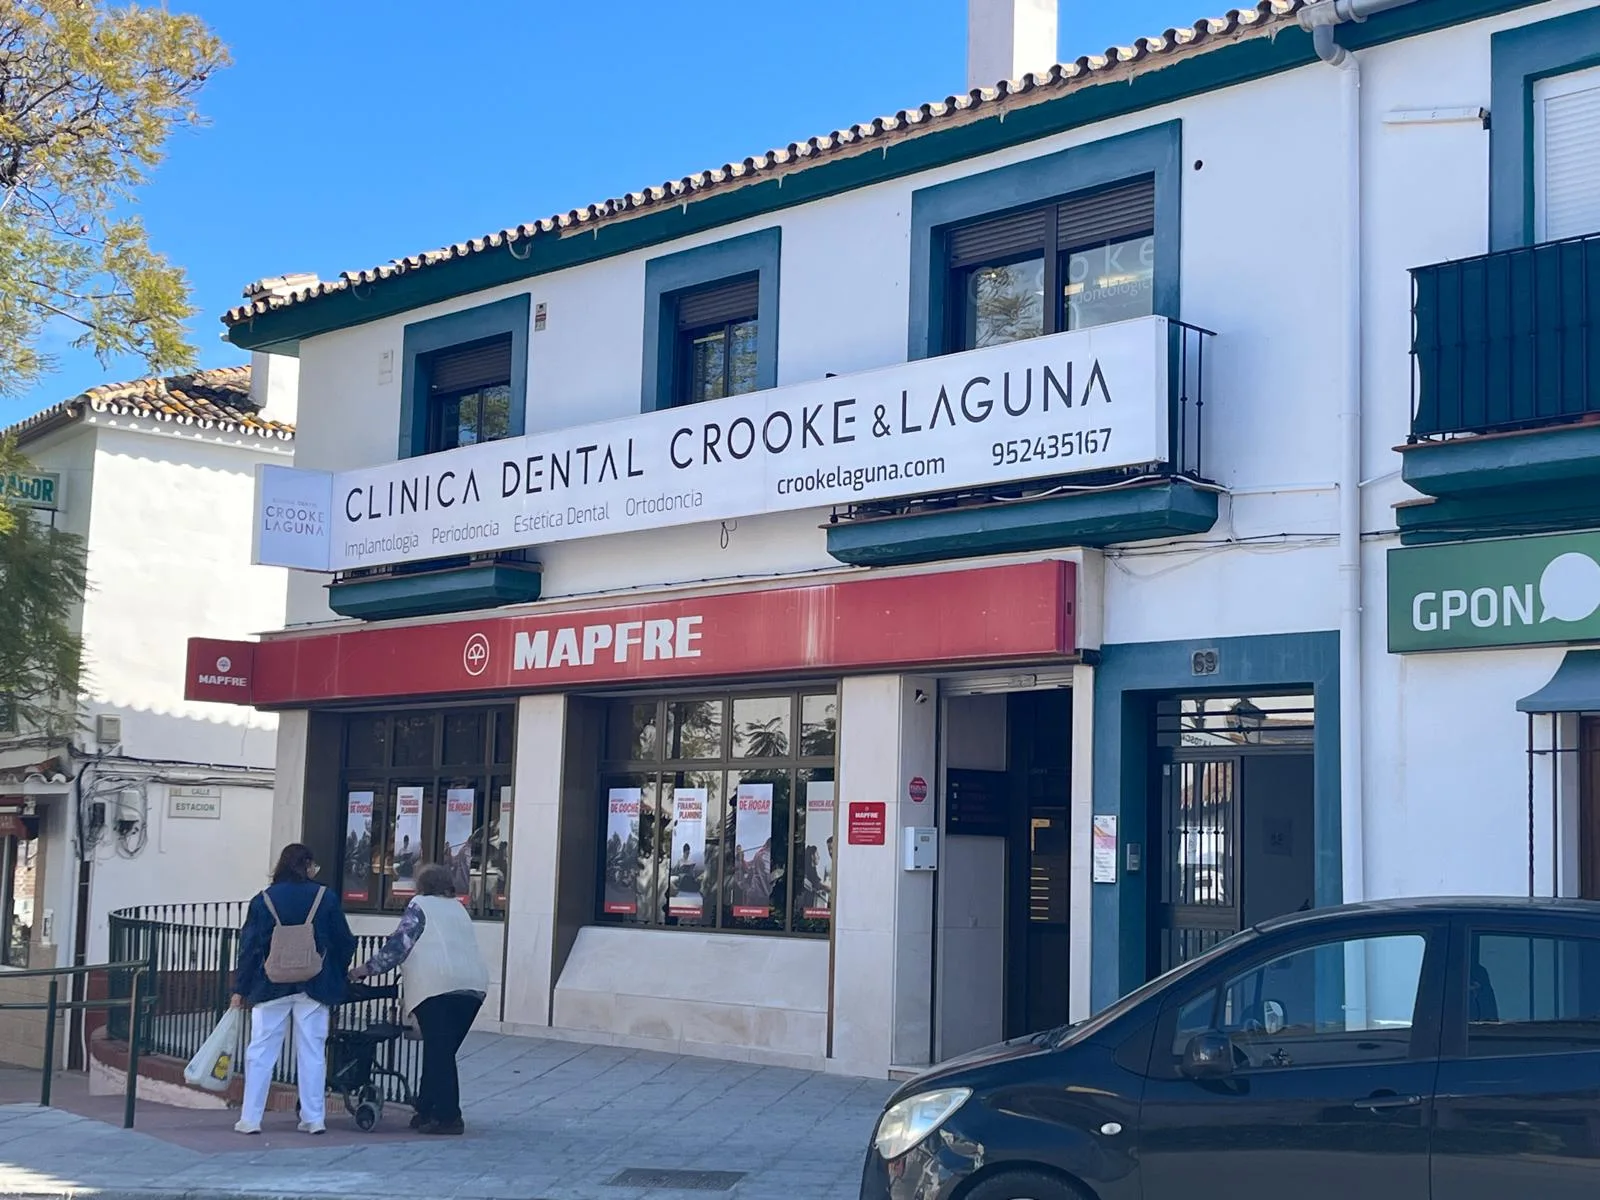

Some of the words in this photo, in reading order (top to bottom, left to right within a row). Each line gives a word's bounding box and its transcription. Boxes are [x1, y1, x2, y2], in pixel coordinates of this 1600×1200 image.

[345, 468, 480, 523] CLINICA
[502, 438, 644, 498] DENTAL
[670, 398, 856, 469] CROOKE
[872, 404, 892, 438] &
[901, 358, 1112, 434] LAGUNA
[992, 428, 1112, 466] 952435167
[777, 457, 945, 495] crookelaguna.com
[265, 505, 325, 523] CROOKE
[265, 519, 325, 537] LAGUNA
[432, 520, 500, 545] Periodoncia
[567, 502, 609, 525] Dental
[626, 490, 703, 517] Ortodoncia
[1412, 583, 1534, 632] GPON
[513, 615, 703, 671] MAPFRE
[199, 674, 248, 687] MAPFRE
[854, 811, 879, 819] MAPFRE
